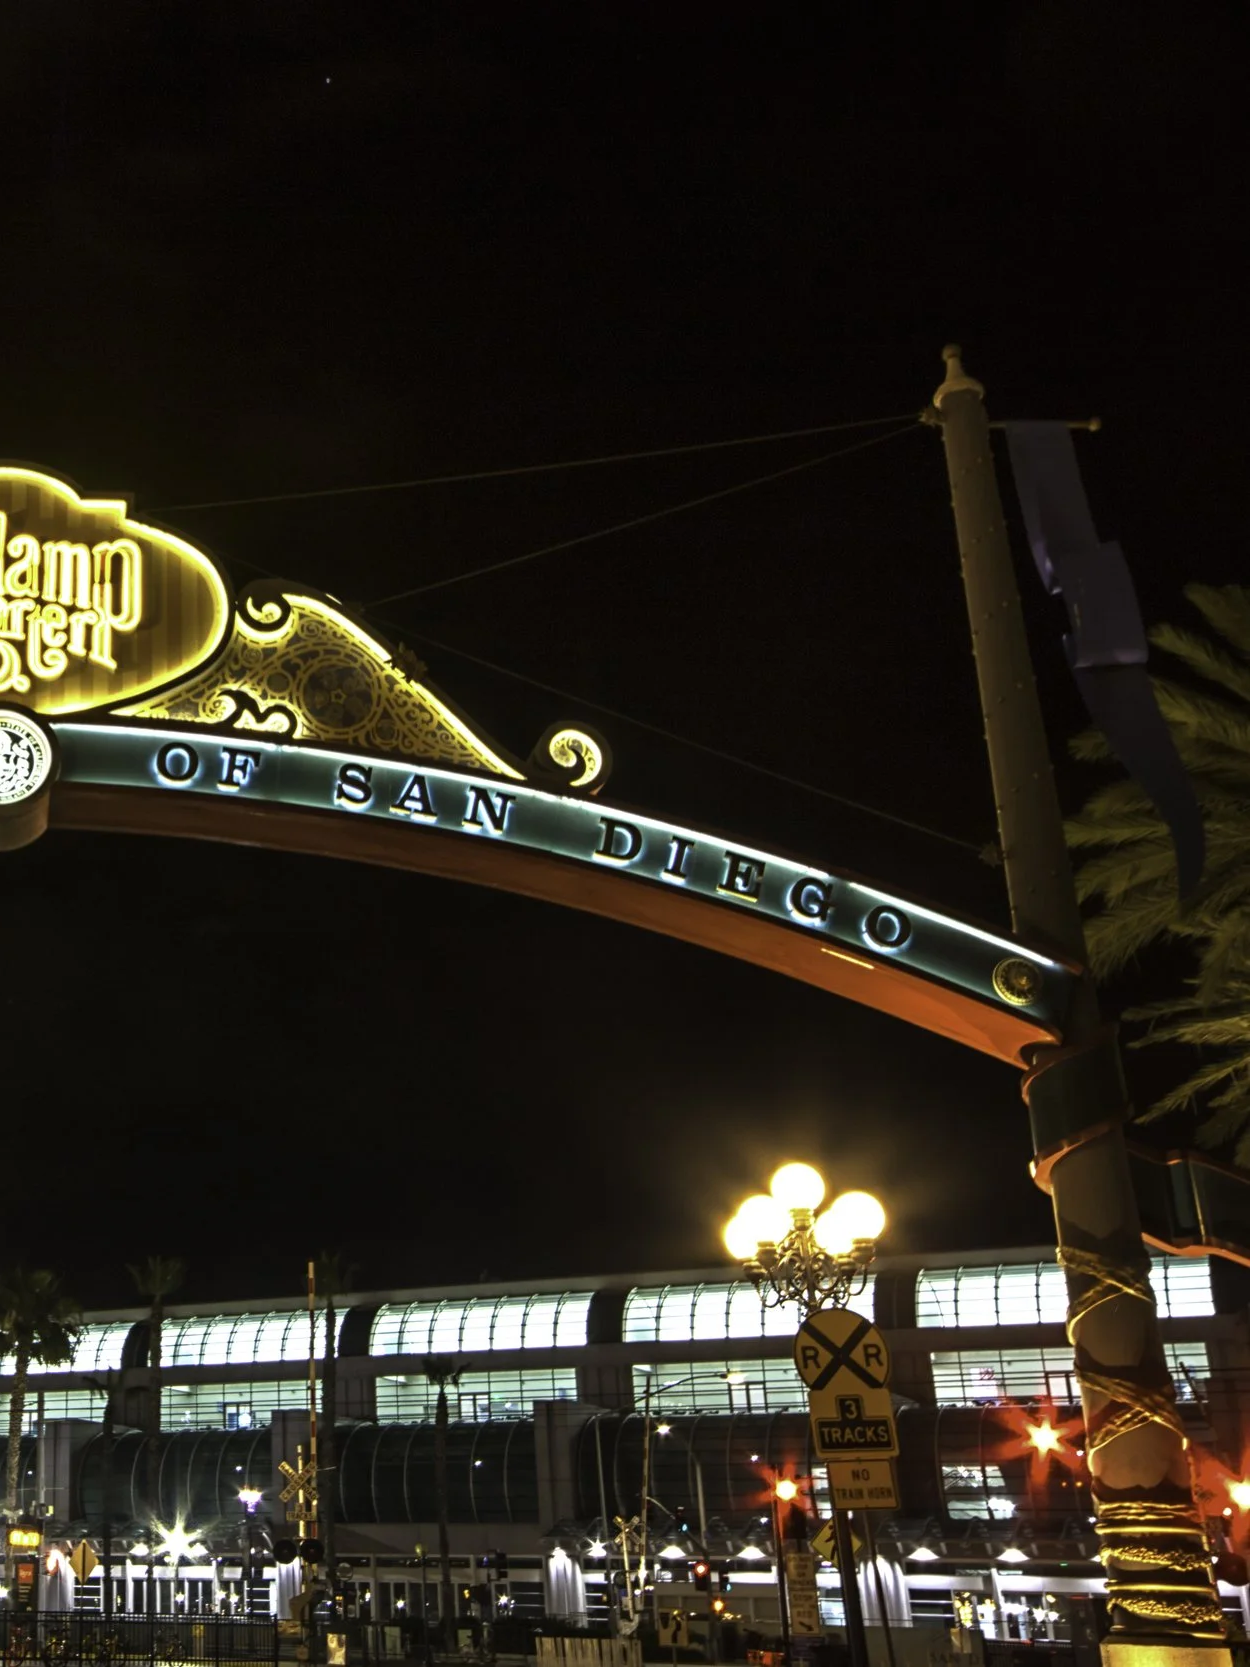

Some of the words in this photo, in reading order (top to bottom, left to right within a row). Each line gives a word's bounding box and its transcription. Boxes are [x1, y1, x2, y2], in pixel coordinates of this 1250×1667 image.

[155, 741, 262, 792] OF
[335, 763, 517, 835] SAN
[593, 816, 912, 953] DIEGO
[801, 1346, 822, 1369] R
[863, 1343, 884, 1367] R
[844, 1400, 858, 1419] 3
[821, 1426, 889, 1444] TRACKS
[851, 1468, 870, 1482] NO
